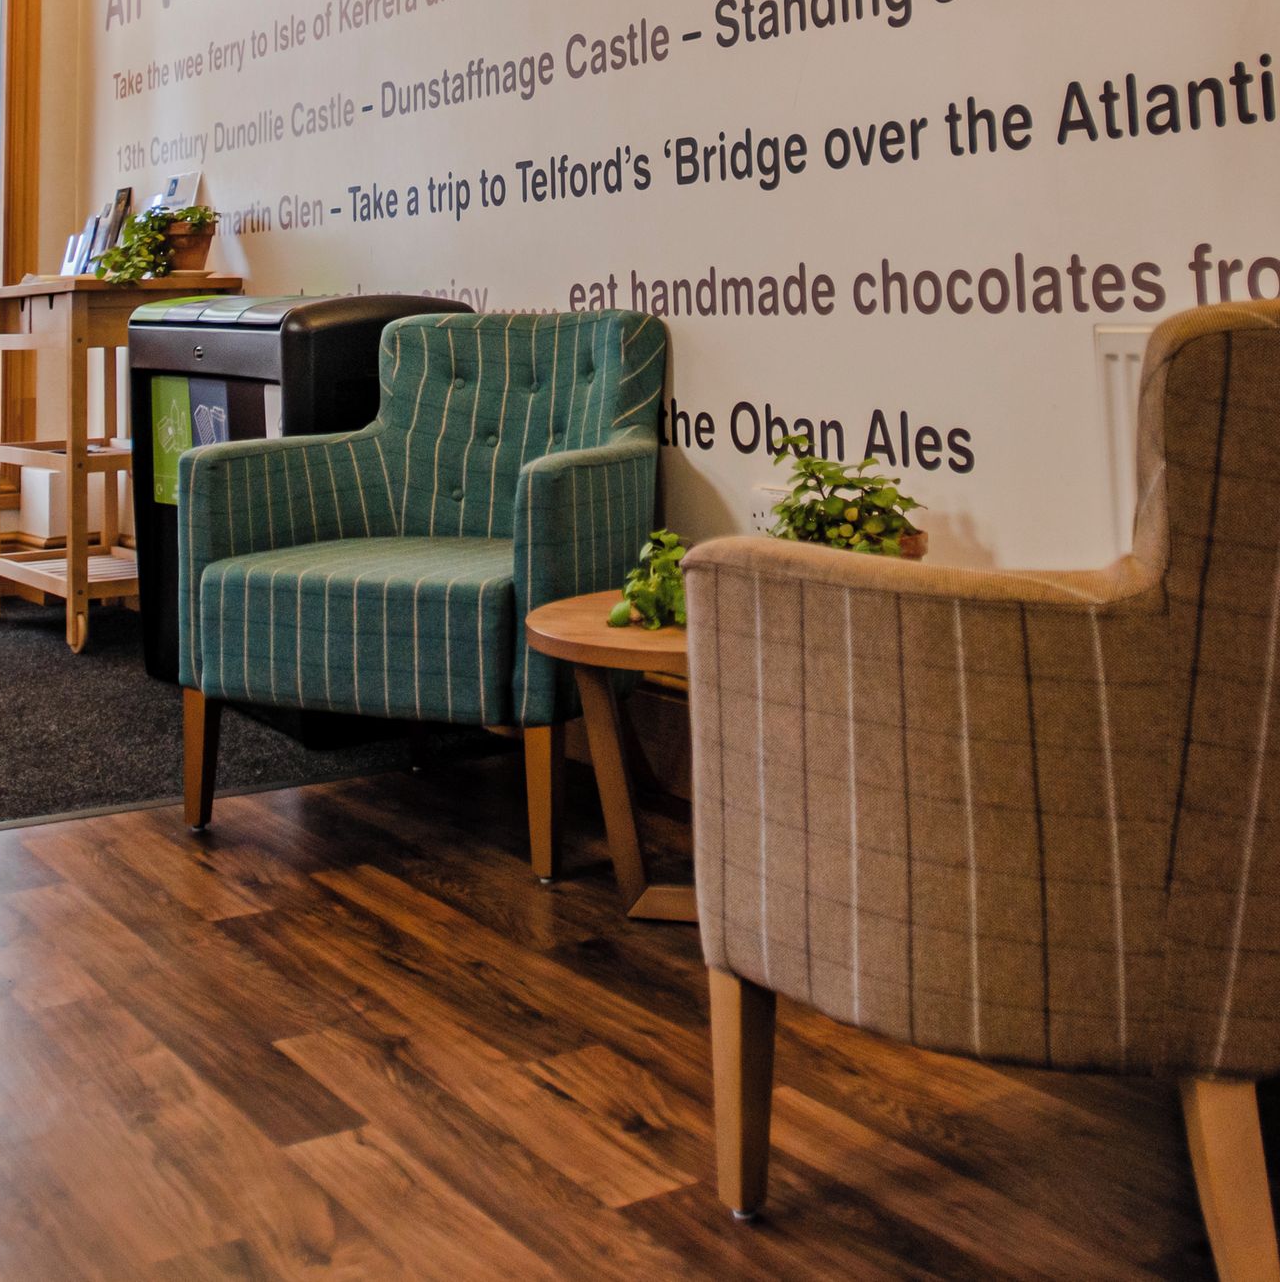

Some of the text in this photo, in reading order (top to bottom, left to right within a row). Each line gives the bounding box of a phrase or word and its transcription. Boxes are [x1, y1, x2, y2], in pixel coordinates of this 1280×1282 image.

[113, 70, 143, 99] Take
[147, 61, 169, 90] the
[174, 53, 203, 82] wee
[208, 39, 245, 73] ferry
[251, 30, 267, 59] to
[274, 14, 306, 52] Isle
[313, 2, 332, 40] of
[117, 141, 145, 172] 13th
[150, 126, 208, 166] Century
[214, 110, 284, 153] Dunollie
[291, 93, 355, 137] Castle
[382, 52, 554, 118] Dunstaffnage
[566, 18, 669, 79] Castle
[219, 200, 271, 236] martin
[279, 195, 323, 230] Glen
[348, 183, 398, 222] Take
[407, 186, 418, 216] a
[428, 177, 470, 221] trip
[479, 169, 506, 207] to
[516, 145, 651, 202] Telford’s
[825, 118, 928, 169] over
[945, 97, 1032, 156] the
[569, 274, 618, 314] eat
[631, 262, 835, 317] handmade
[853, 253, 1166, 315] chocolates
[659, 398, 976, 474] the Oban Ales
